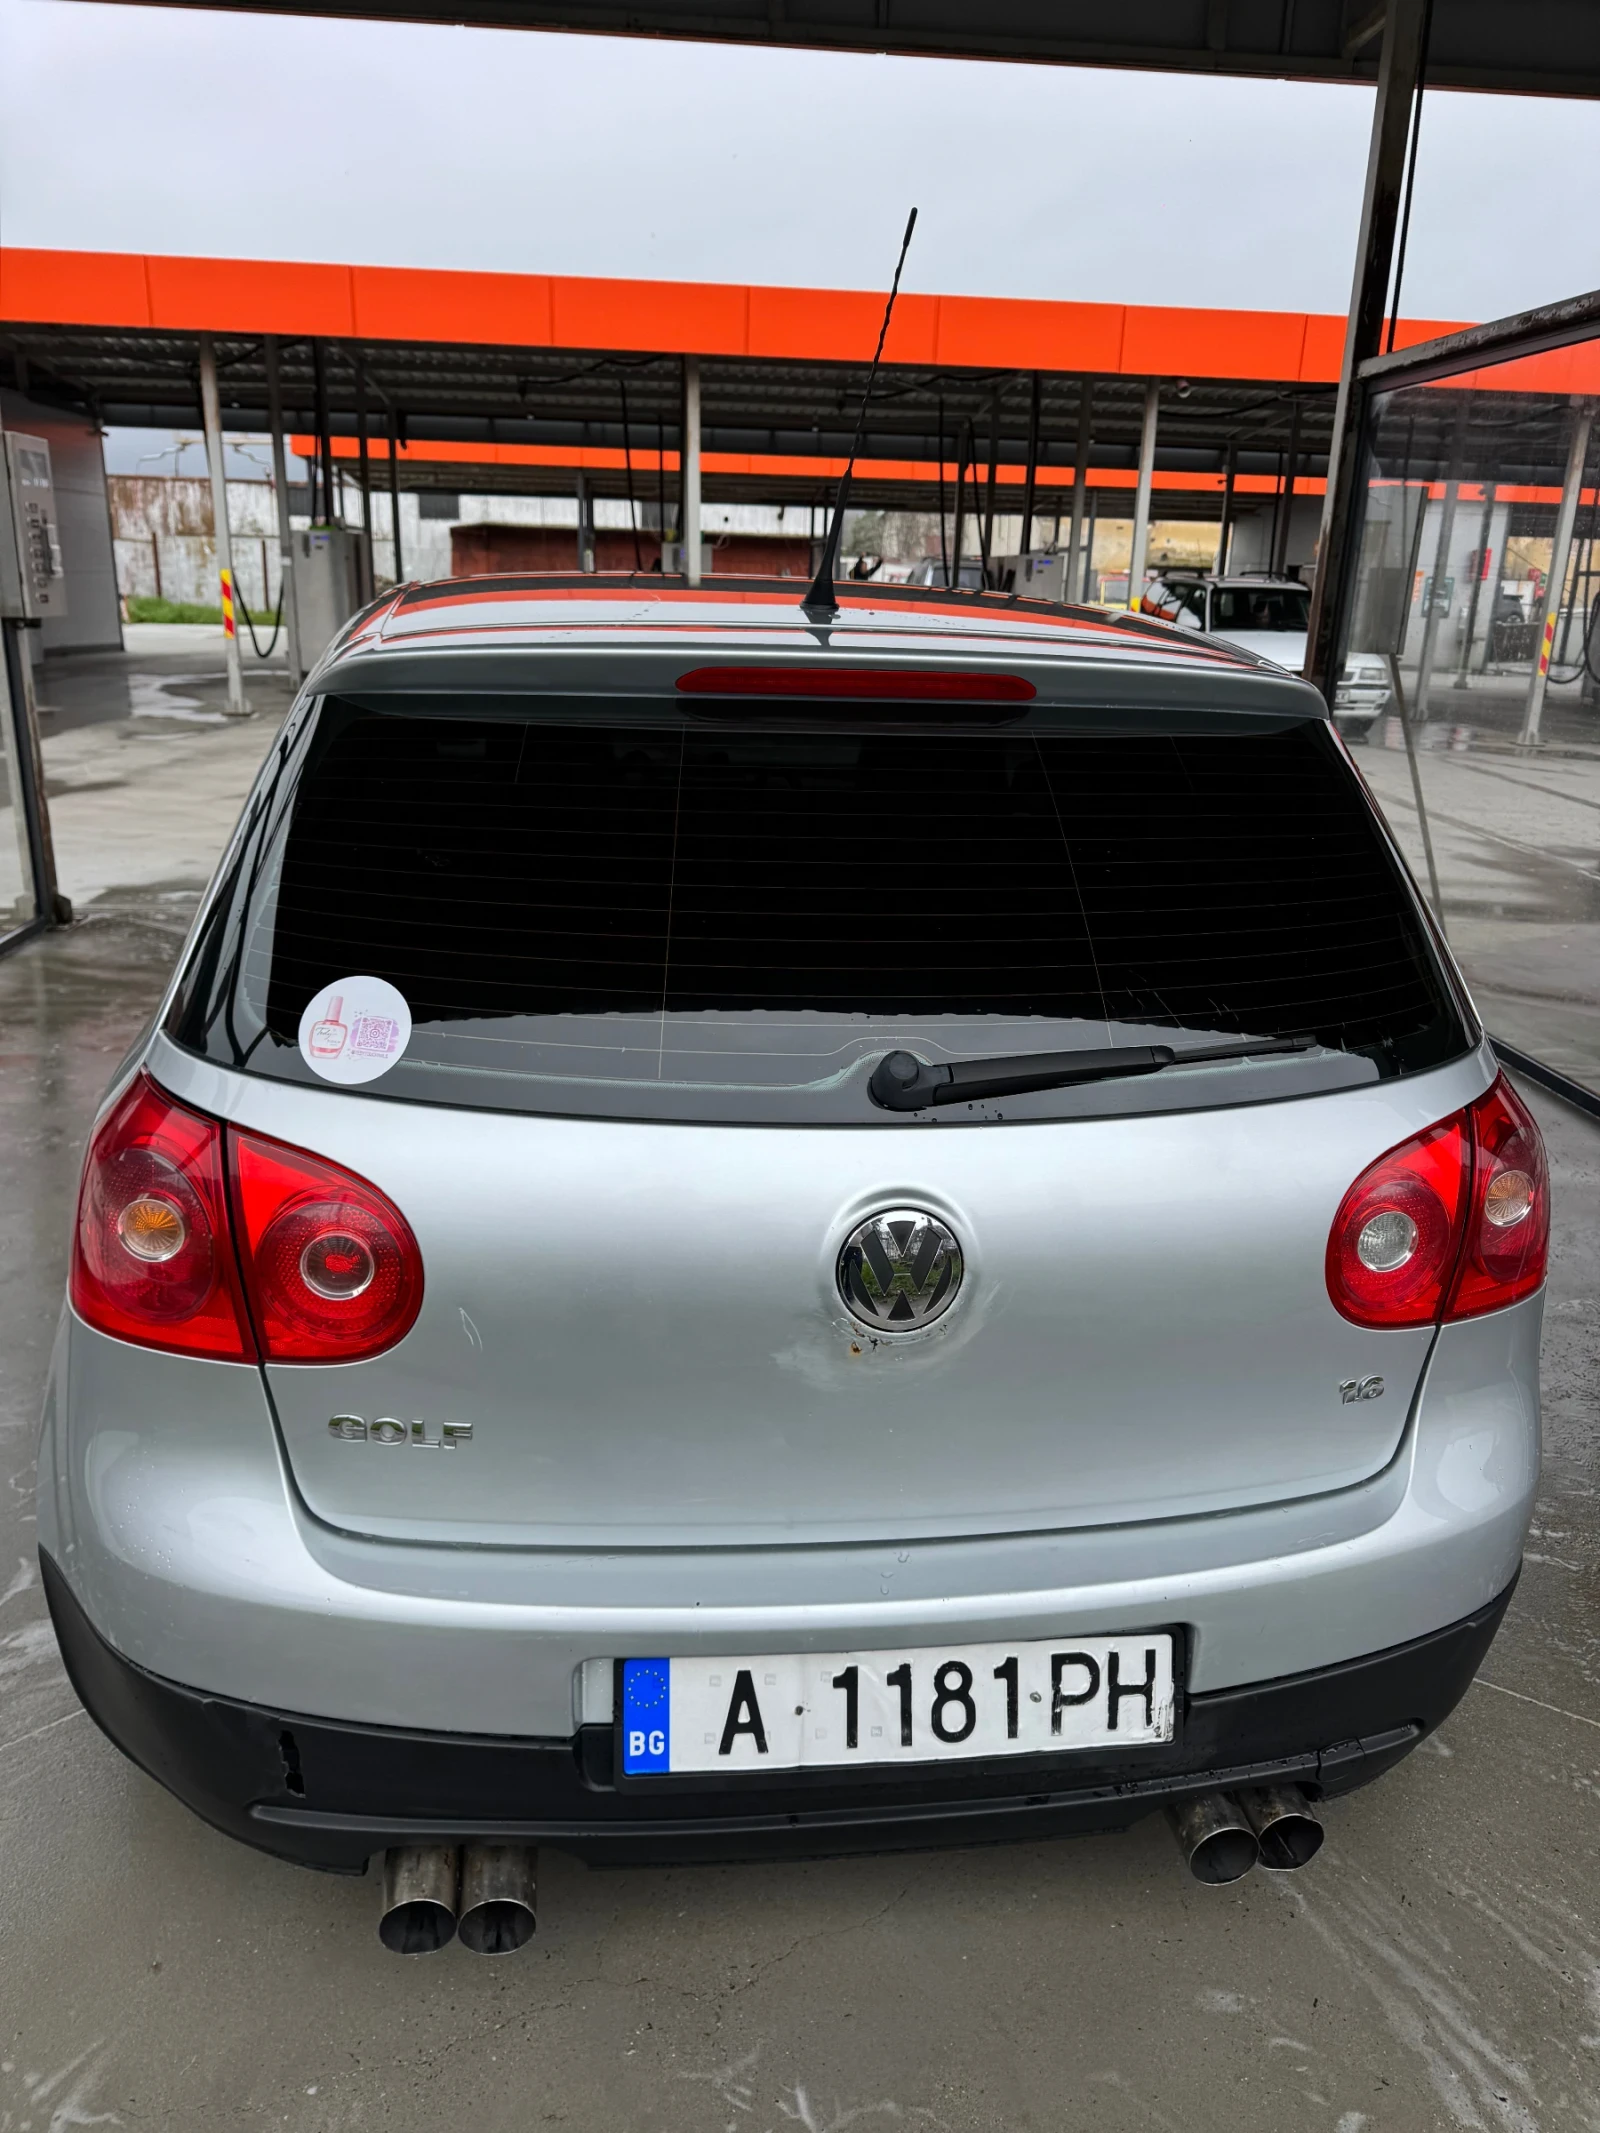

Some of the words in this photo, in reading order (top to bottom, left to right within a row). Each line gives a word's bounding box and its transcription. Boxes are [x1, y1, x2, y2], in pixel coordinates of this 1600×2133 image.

[840, 1212, 961, 1330] VW
[327, 1413, 473, 1450] GOLF
[718, 1669, 769, 1756] A
[832, 1655, 1020, 1750] 1181
[1051, 1648, 1157, 1736] PH
[629, 1730, 665, 1757] BG
